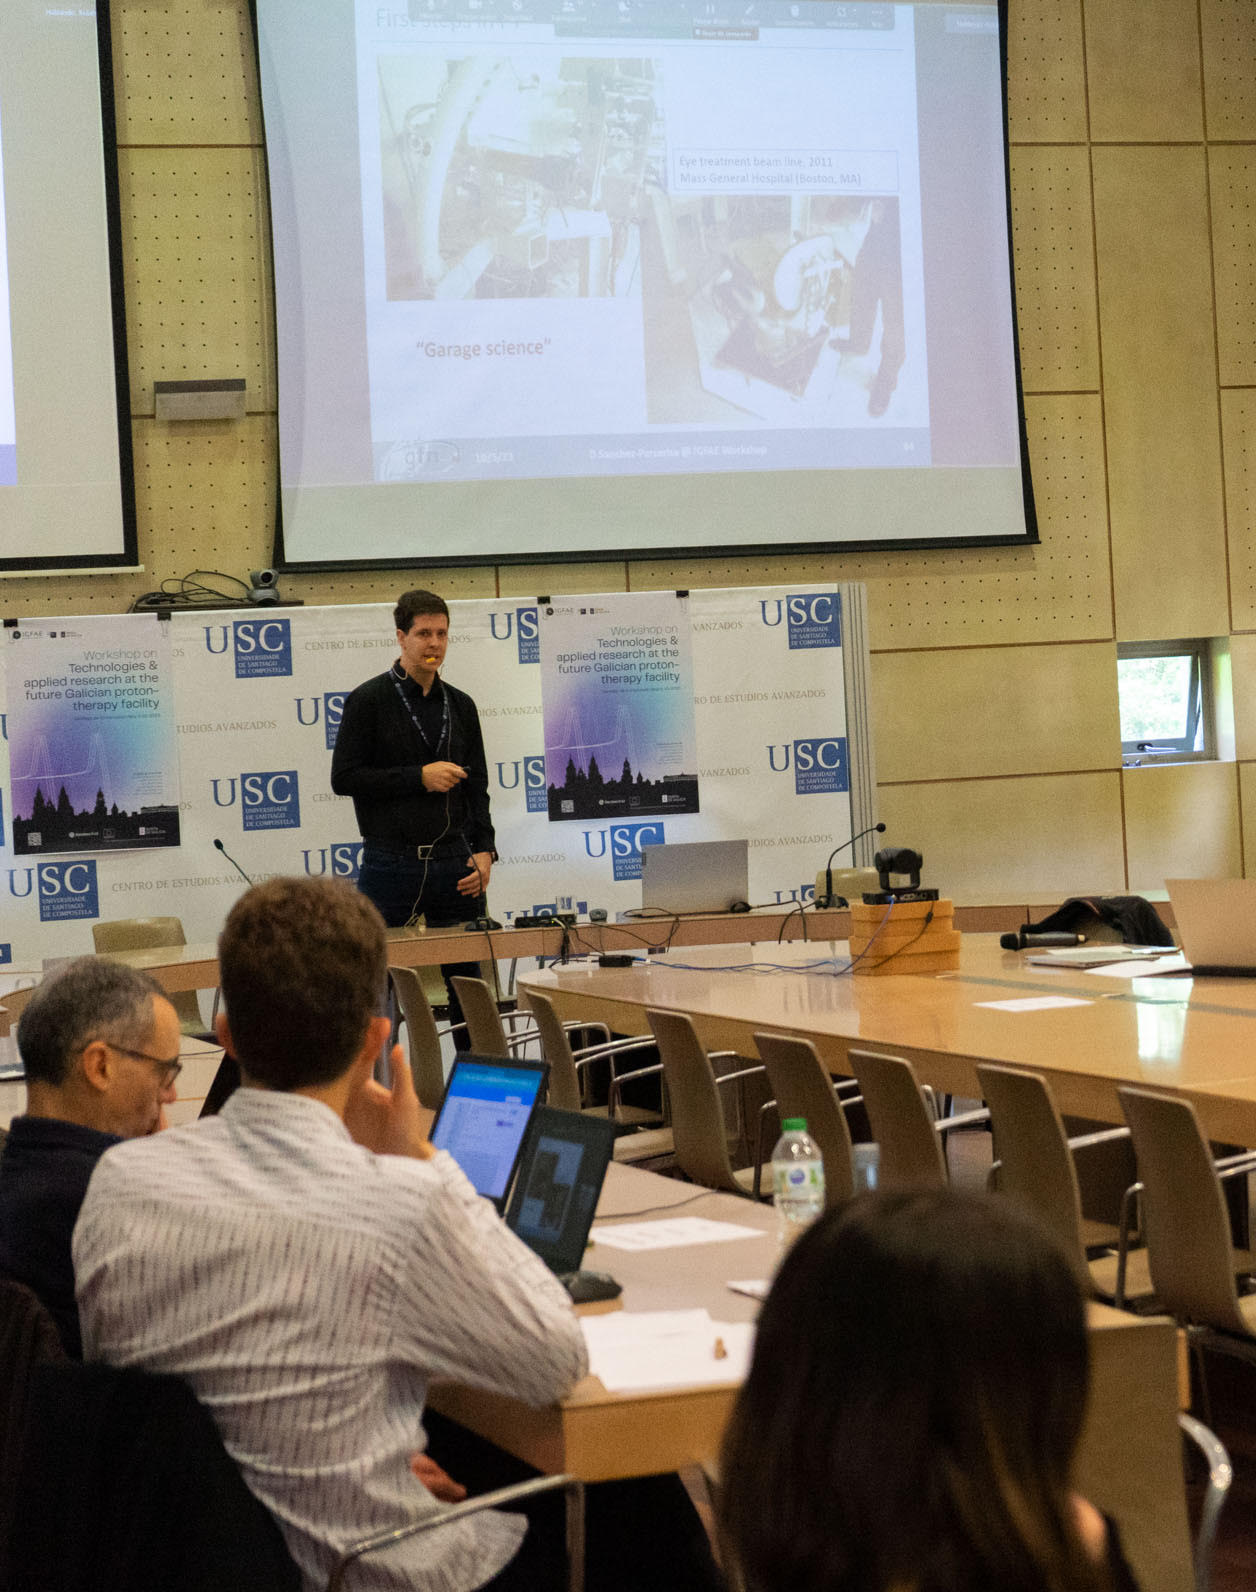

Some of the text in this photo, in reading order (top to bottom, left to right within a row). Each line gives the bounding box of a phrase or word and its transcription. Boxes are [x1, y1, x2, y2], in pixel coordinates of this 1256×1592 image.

[679, 156, 698, 169] Eye
[699, 156, 751, 167] treatment
[753, 156, 782, 167] beam
[809, 156, 834, 168] 2011
[680, 173, 707, 184] Mass
[709, 173, 749, 184] General
[752, 172, 794, 186] Hospital
[840, 172, 862, 186] MA)
[758, 596, 834, 627] USC
[610, 624, 678, 638] Workshop on
[203, 623, 285, 654] USC
[362, 637, 397, 648] ESTUDI
[597, 636, 679, 650] Technologies &
[84, 649, 158, 662] Workshop on
[557, 648, 680, 663] applied research at the
[69, 660, 159, 675] Technologies &
[559, 662, 592, 674] future
[594, 661, 637, 673] Galician
[24, 673, 160, 691] applied research at the
[601, 672, 681, 686] therapy facility
[26, 689, 63, 701] future
[65, 687, 112, 700] Galician
[73, 699, 161, 713] therapy facility
[176, 719, 278, 734] TUDIOS AVANZADOS
[766, 741, 841, 772] USC
[700, 766, 751, 778] VANZADOS
[210, 774, 292, 807] USC
[582, 827, 658, 858] USC
[6, 864, 90, 898] USC
